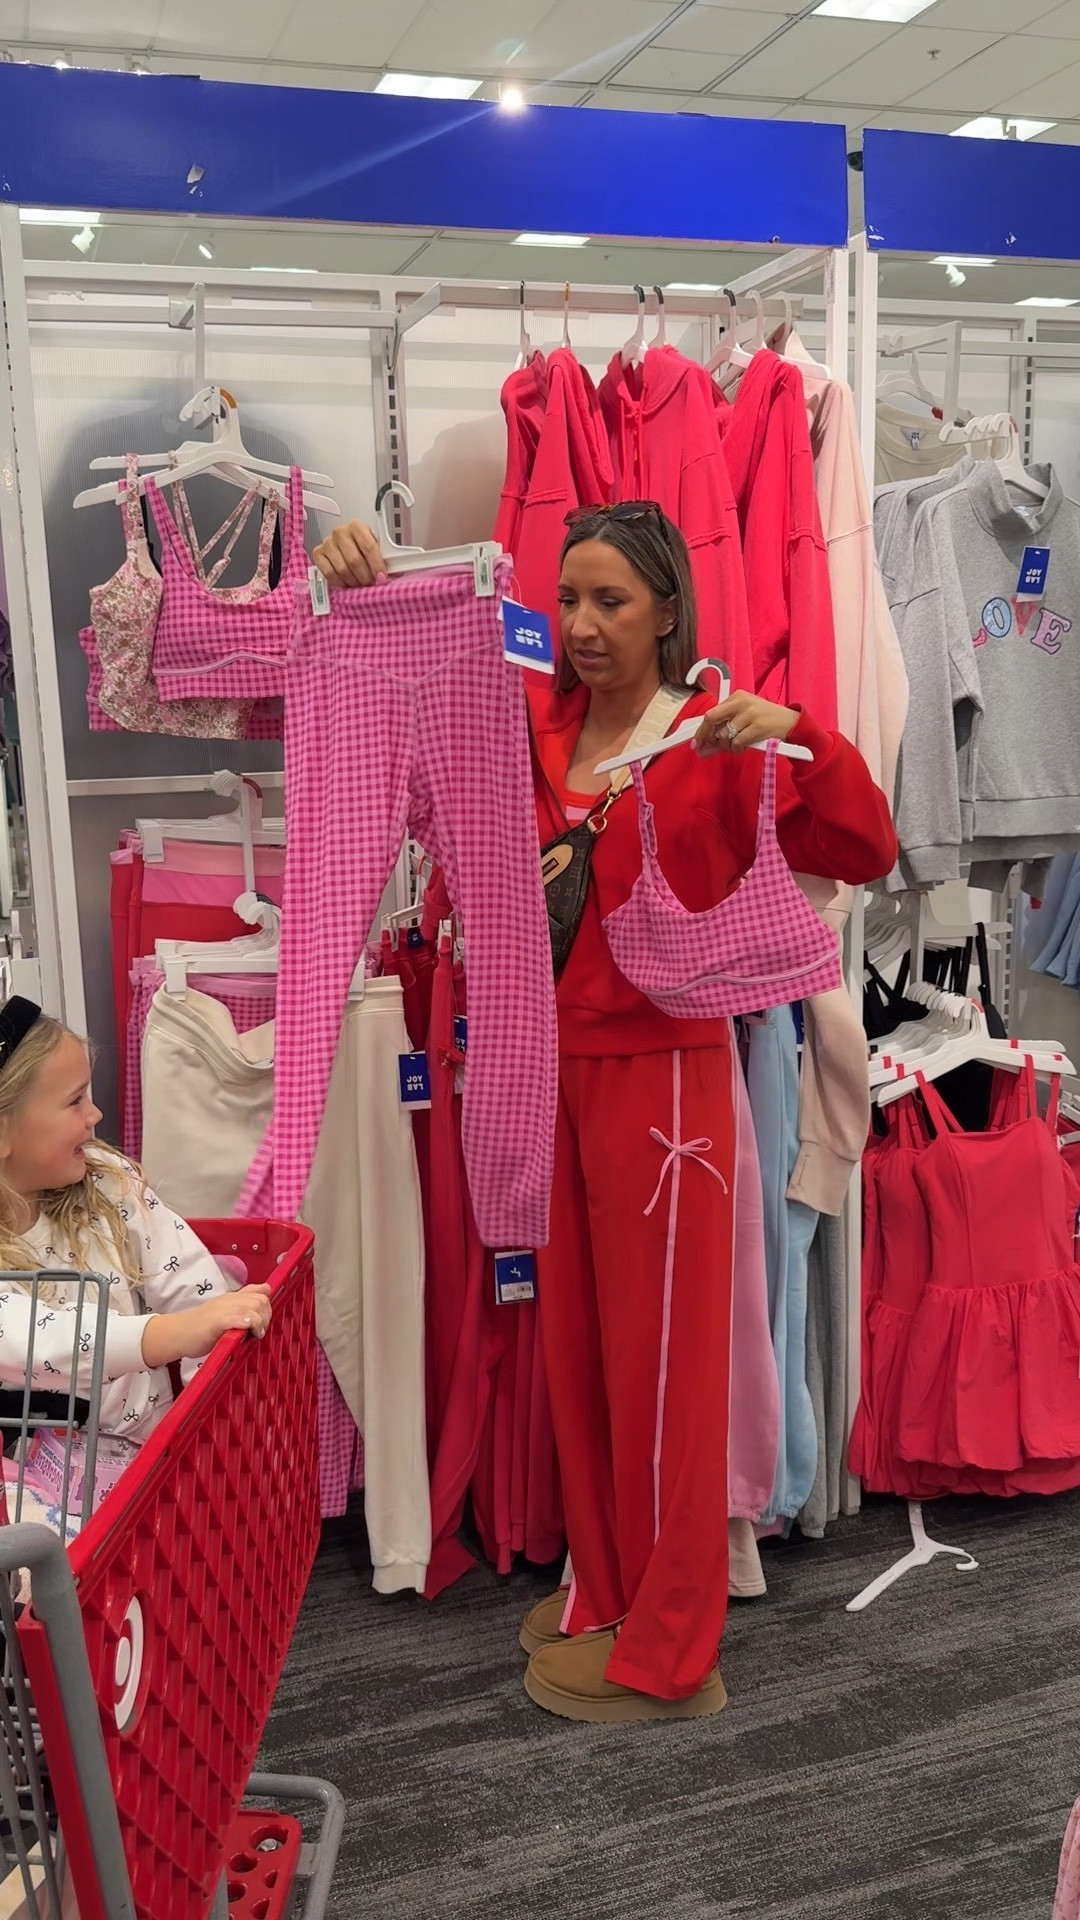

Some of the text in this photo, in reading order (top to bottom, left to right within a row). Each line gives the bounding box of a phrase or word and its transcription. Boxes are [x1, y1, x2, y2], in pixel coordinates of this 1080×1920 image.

[1026, 568, 1042, 576] JOY
[972, 597, 1072, 655] OVE
[514, 627, 541, 639] JOY
